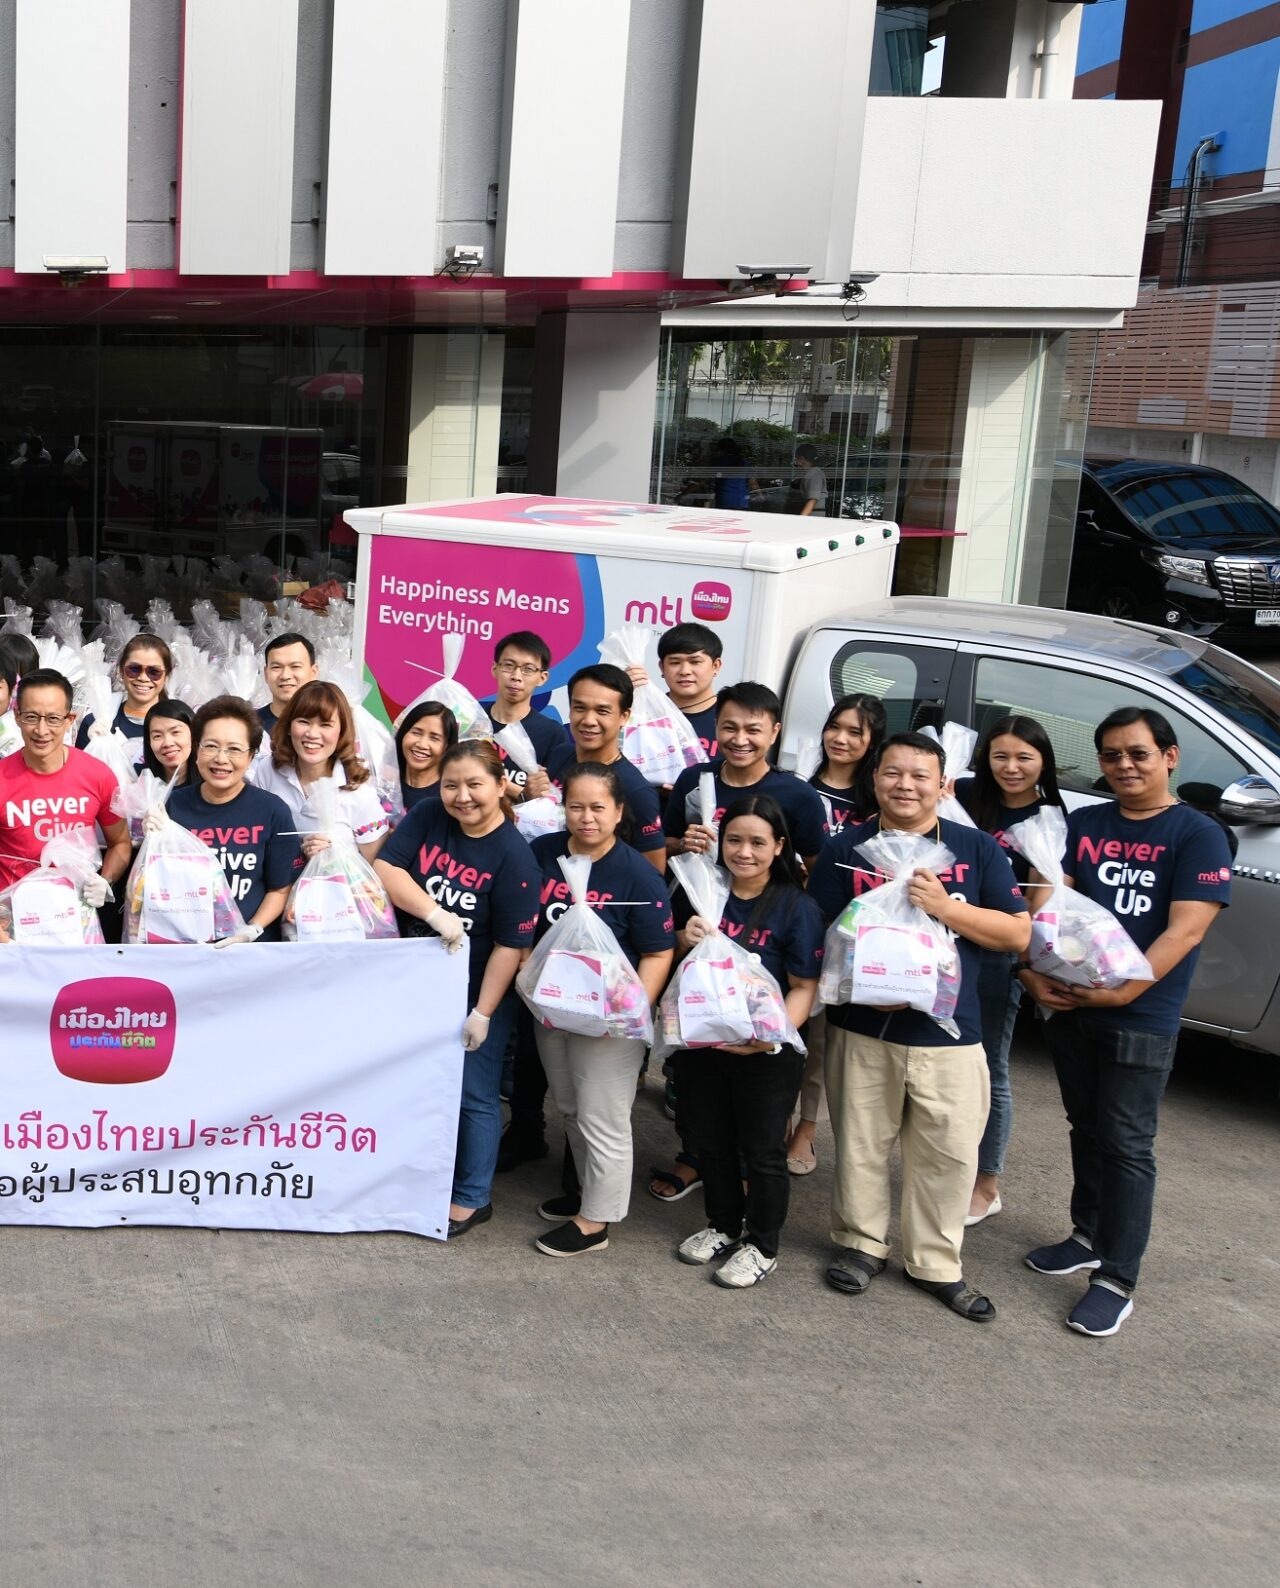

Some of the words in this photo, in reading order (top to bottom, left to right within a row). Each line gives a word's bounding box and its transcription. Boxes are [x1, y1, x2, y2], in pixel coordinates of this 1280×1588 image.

[380, 575, 490, 606] Happiness
[495, 587, 570, 615] Means
[378, 605, 493, 640] Everything
[625, 595, 683, 627] mtl
[6, 797, 89, 827] Never
[191, 826, 264, 845] ever
[1077, 836, 1166, 864] Never
[419, 843, 492, 890] Never
[1097, 861, 1156, 887] Give
[425, 875, 477, 910] Give
[1114, 888, 1152, 916] Up
[59, 1006, 167, 1029] เมืองไทย
[69, 1031, 156, 1048] ประกันชีวิต
[4, 1109, 377, 1153] เมืองไทยประกันชีวิต
